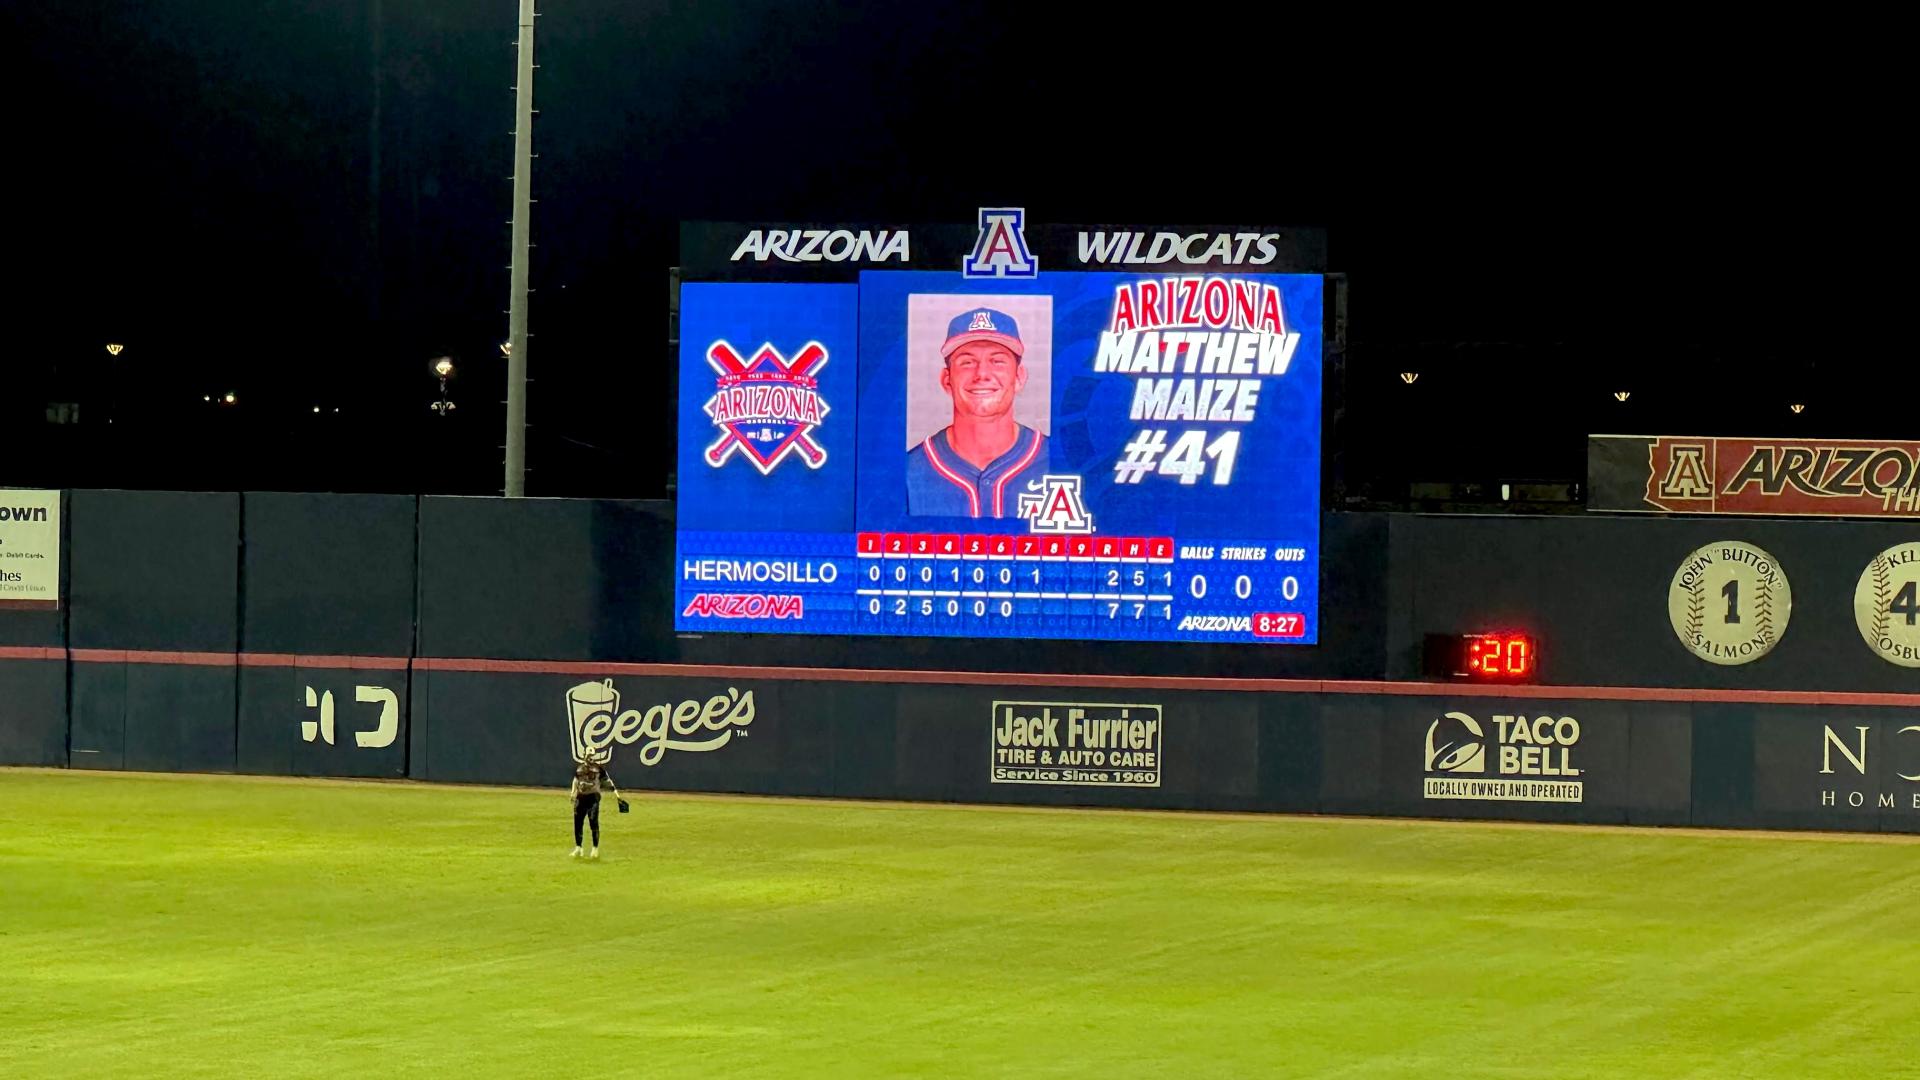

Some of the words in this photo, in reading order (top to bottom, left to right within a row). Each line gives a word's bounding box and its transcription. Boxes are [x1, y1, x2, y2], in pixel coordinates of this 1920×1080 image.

[730, 230, 909, 262] ARIZONA
[963, 207, 1038, 279] A
[1078, 232, 1280, 265] WILDCATS
[1110, 277, 1287, 336] ARIZONA
[1094, 331, 1300, 374] MATTHEW
[713, 386, 821, 425] ARIZONA
[1129, 378, 1262, 421] MAIZE
[1114, 430, 1241, 485] #41
[1659, 444, 1713, 499] A
[868, 540, 873, 551] 1
[892, 540, 901, 551] 2
[919, 541, 926, 551] 3
[944, 541, 953, 552] 4
[971, 541, 979, 552] 5
[997, 542, 1005, 552] 6
[1024, 542, 1032, 553] 7
[1050, 543, 1058, 553] 8
[1077, 543, 1086, 554] 9
[1103, 544, 1112, 555] R
[1130, 544, 1138, 555] H
[1157, 545, 1164, 555] E
[1180, 547, 1215, 559] BALLS
[1220, 547, 1267, 560] STRIKES
[1274, 548, 1305, 561] OUTS
[684, 560, 837, 583] HERMOSILLO
[869, 565, 880, 581] 0
[895, 566, 906, 582] 0
[921, 566, 932, 582] 0
[951, 567, 959, 582] 1
[973, 567, 984, 583] 0
[1000, 568, 1011, 584] 0
[1031, 569, 1039, 584] 1
[1108, 570, 1119, 586] 2
[1133, 570, 1144, 586] 5
[1163, 571, 1172, 587] 1
[1191, 574, 1207, 599] 0
[1235, 575, 1252, 599] 0
[1282, 576, 1298, 601] 0
[1679, 553, 1713, 591] JOHN
[683, 593, 803, 619] ARIZONA
[869, 599, 880, 614] 0
[895, 599, 906, 615] 2
[921, 600, 932, 615] 5
[947, 600, 958, 616] 0
[974, 600, 985, 616] 0
[1001, 601, 1012, 617] 0
[1108, 603, 1119, 619] 7
[1133, 604, 1144, 619] 7
[1163, 604, 1171, 620] 1
[1722, 580, 1740, 624] 1
[1890, 581, 1920, 625] 4
[1177, 616, 1252, 632] ARIZONA
[1259, 617, 1298, 633] 8:27
[1692, 634, 1767, 658] SALMON
[583, 687, 755, 766] eegee's
[997, 707, 1059, 747] Jack
[1068, 709, 1157, 750] Furrier
[1492, 715, 1580, 746] TACO
[997, 749, 1036, 764] TIRE
[1040, 750, 1052, 764] &
[1058, 750, 1105, 766] AUTO
[1110, 752, 1155, 767] CARE
[1500, 746, 1579, 776] BELL
[996, 768, 1058, 781] Service
[1062, 770, 1108, 782] Since
[1113, 771, 1155, 783] 1960
[1427, 781, 1468, 796] LOCALLY
[1471, 782, 1505, 797] OWNED
[1509, 783, 1527, 797] AND
[1531, 784, 1579, 799] OPERATED
